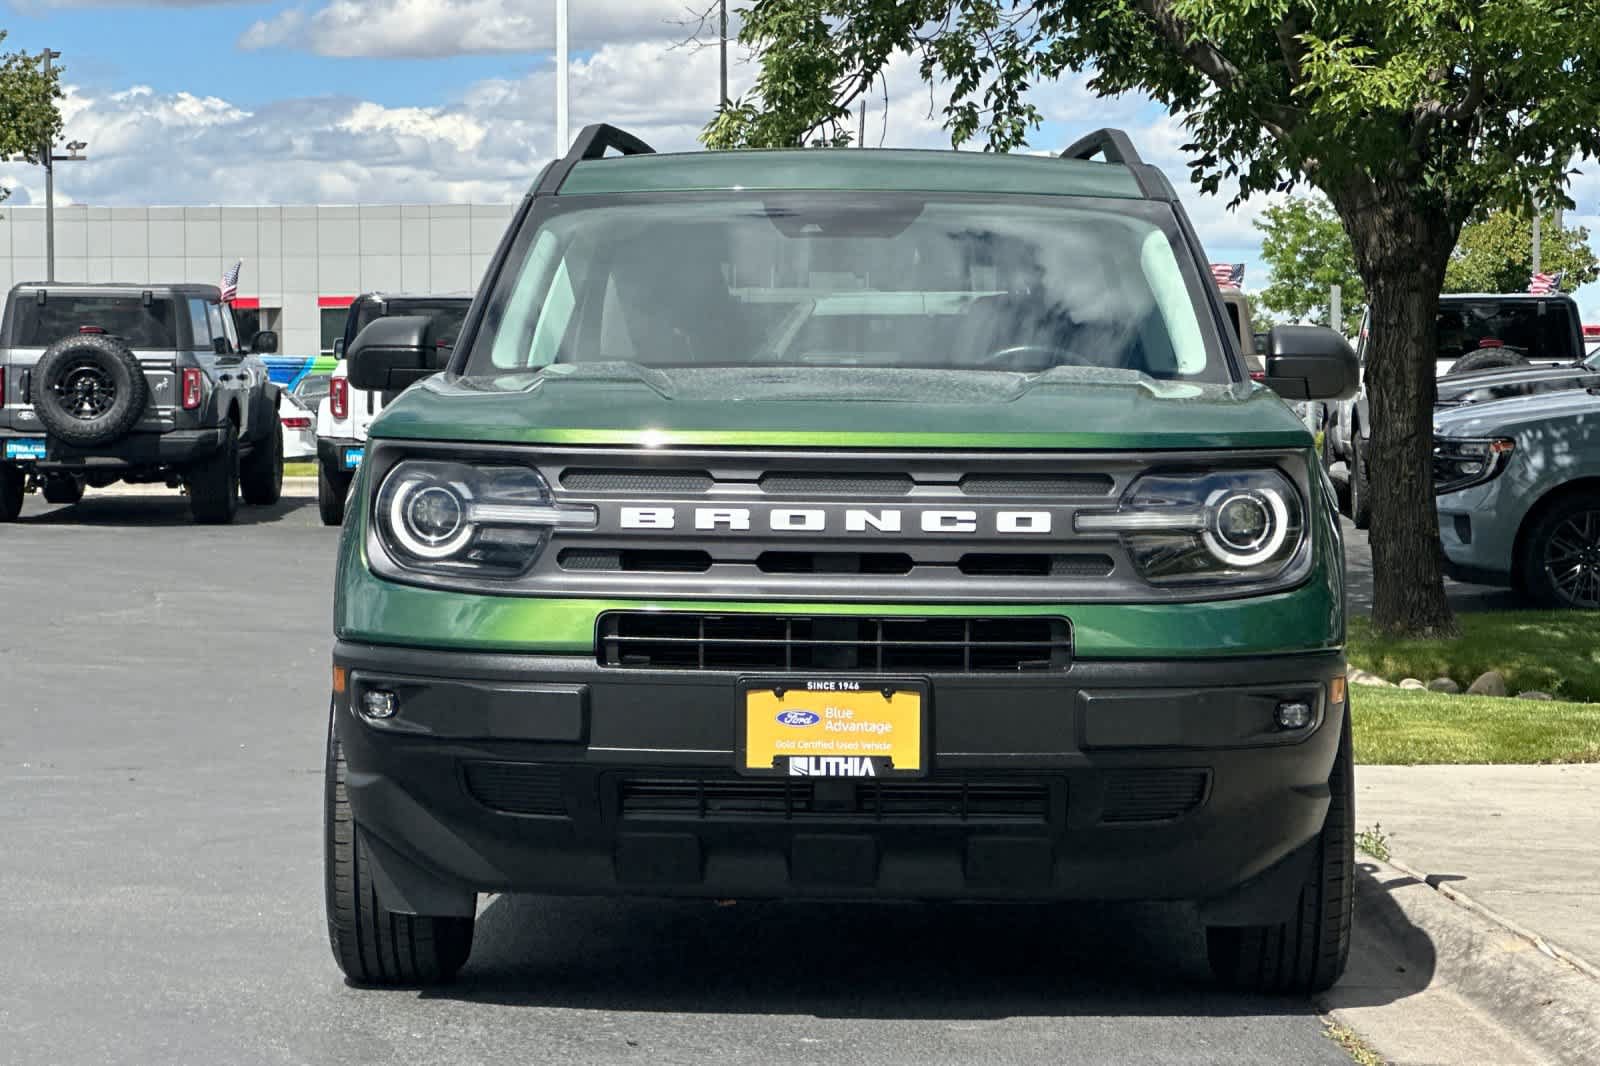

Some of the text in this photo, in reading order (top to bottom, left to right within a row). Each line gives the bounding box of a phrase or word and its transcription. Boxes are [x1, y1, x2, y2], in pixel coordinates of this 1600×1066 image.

[620, 507, 1052, 533] BRONCO
[807, 682, 860, 690] SINCE 1946
[784, 711, 813, 725] Ford
[825, 706, 854, 719] Blue
[825, 720, 893, 734] Advantage
[775, 740, 892, 751] Gold Certified Used Vehicle
[808, 756, 876, 777] LITHIA
